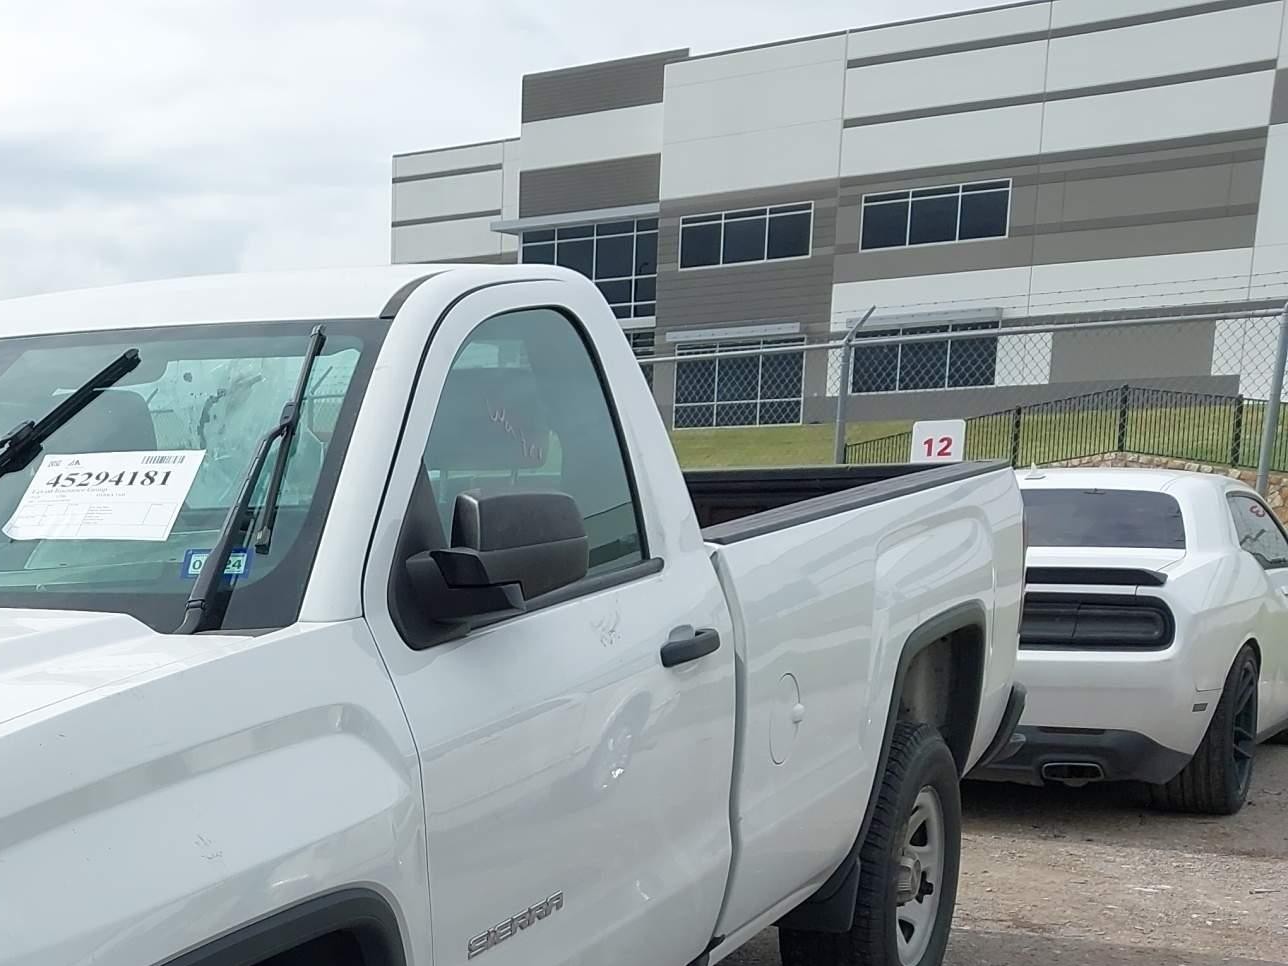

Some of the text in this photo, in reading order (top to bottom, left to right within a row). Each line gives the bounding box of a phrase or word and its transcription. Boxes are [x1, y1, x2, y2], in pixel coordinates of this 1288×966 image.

[922, 436, 953, 457] 12
[45, 469, 172, 488] 45294181
[467, 889, 564, 961] SIERRA
